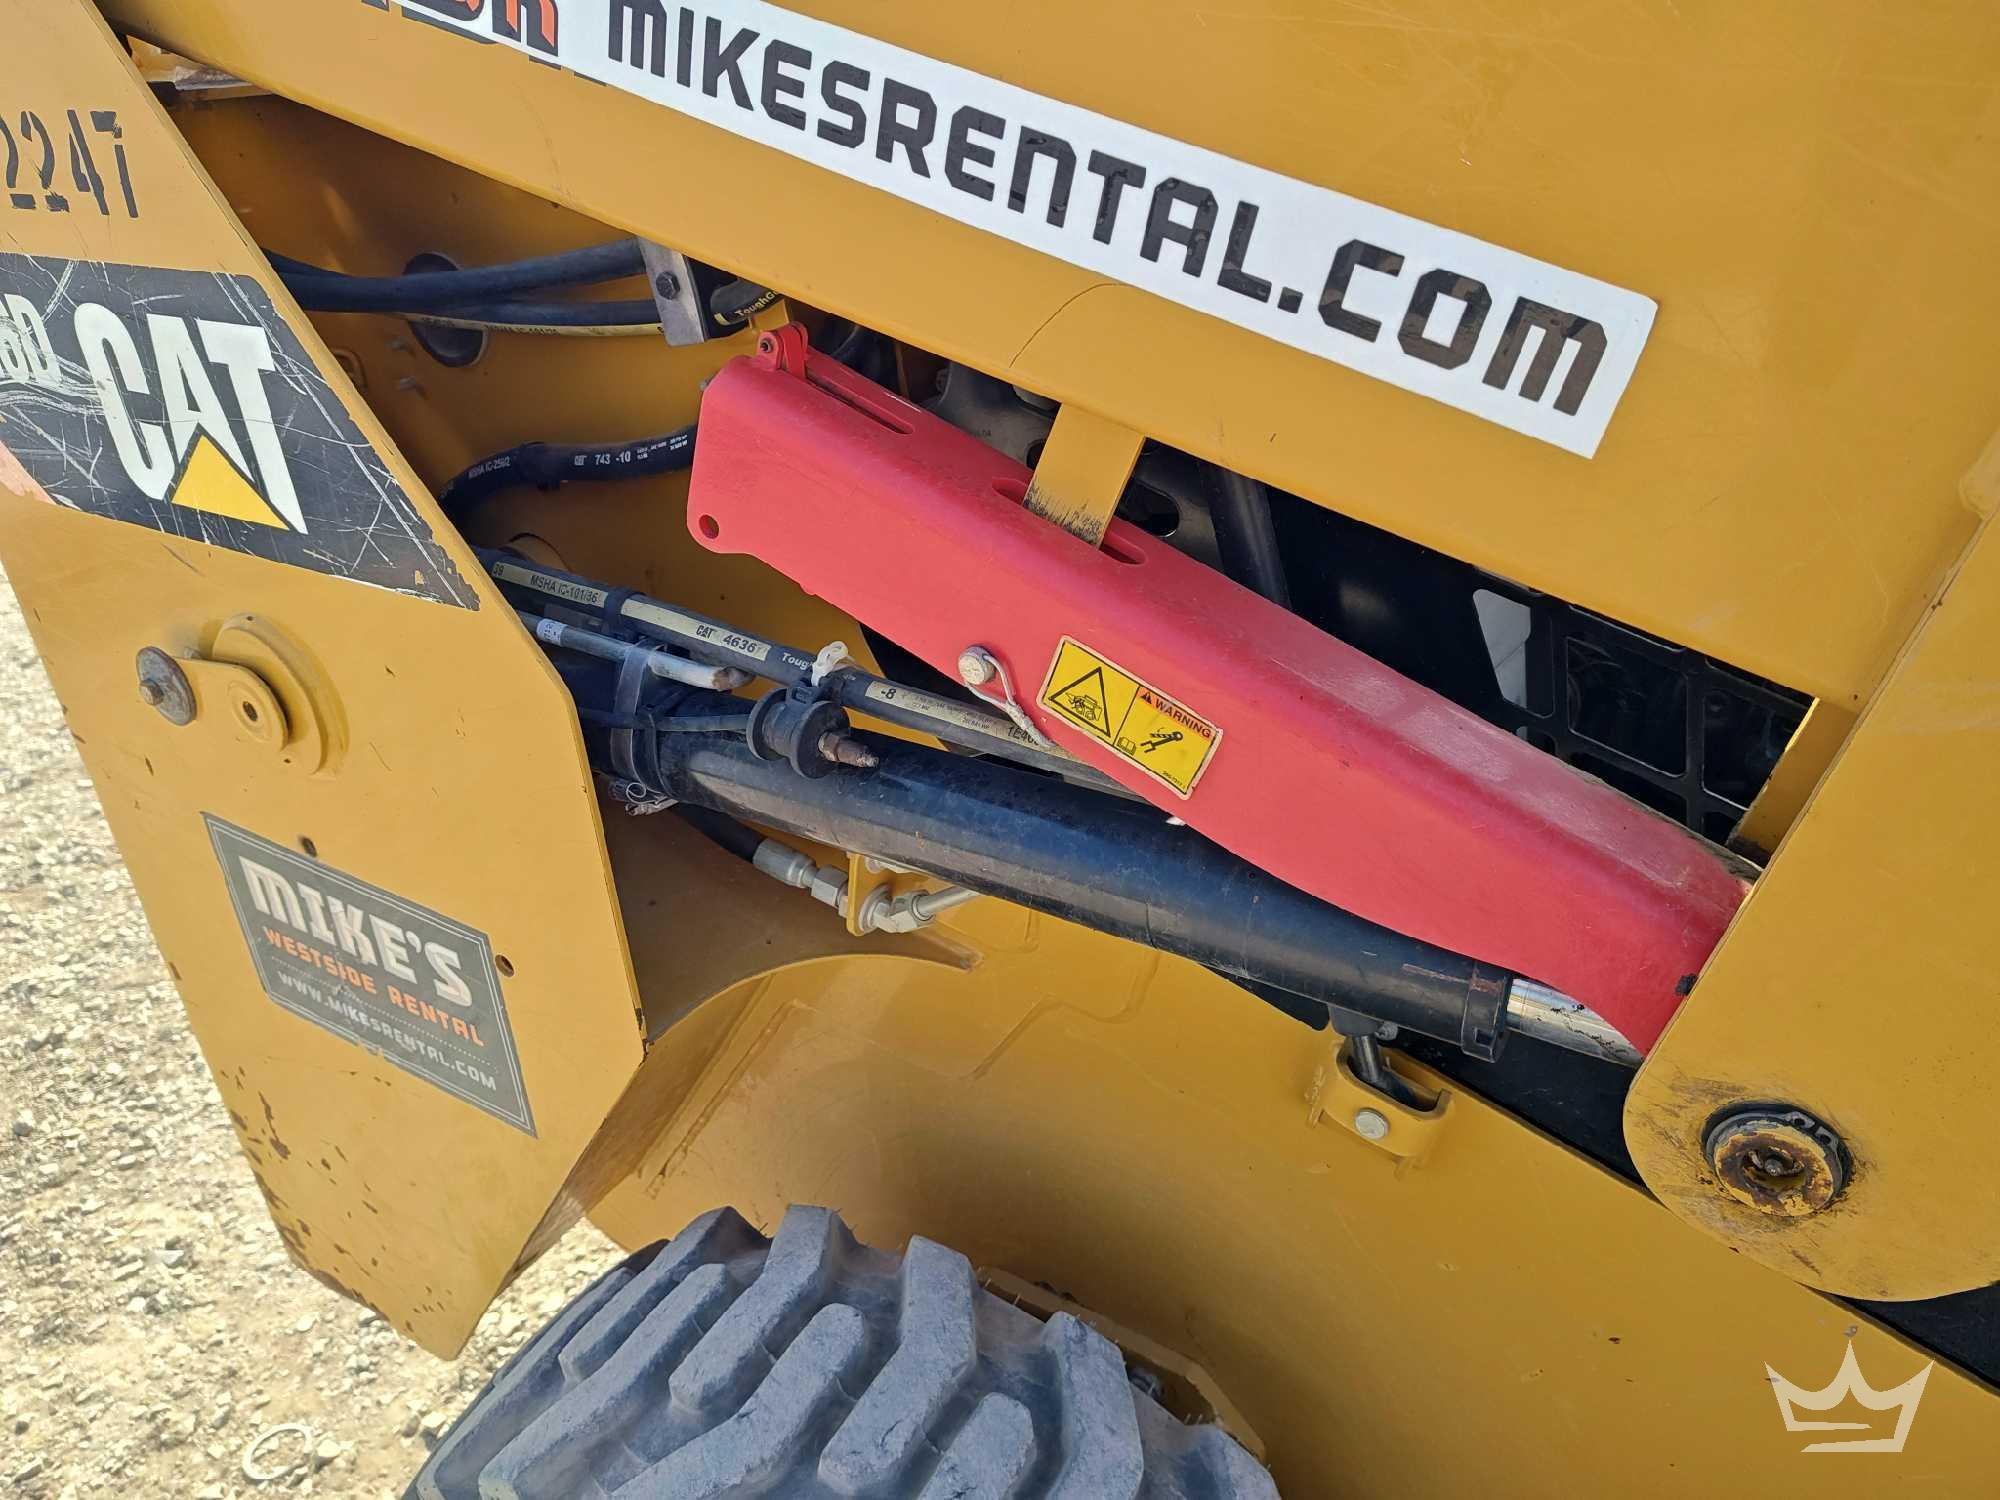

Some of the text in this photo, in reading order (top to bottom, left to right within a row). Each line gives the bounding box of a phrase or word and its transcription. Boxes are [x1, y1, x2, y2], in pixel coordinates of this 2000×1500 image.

[608, 0, 1609, 417] MIKESRENTAL.COM
[734, 289, 779, 316] ToughG
[74, 302, 309, 535] CAT
[594, 453, 611, 465] 743
[615, 450, 631, 463] -10
[530, 574, 556, 593] MSHA
[696, 624, 757, 653] CAT 4636
[782, 652, 813, 670] Toug
[880, 688, 897, 700] -8
[1155, 698, 1212, 739] WARNING
[238, 855, 473, 1008] MIKE'S
[262, 926, 485, 1047] WESTSIDE RENTAL
[277, 970, 498, 1091] WWW.MIKESRENTAL.COM
